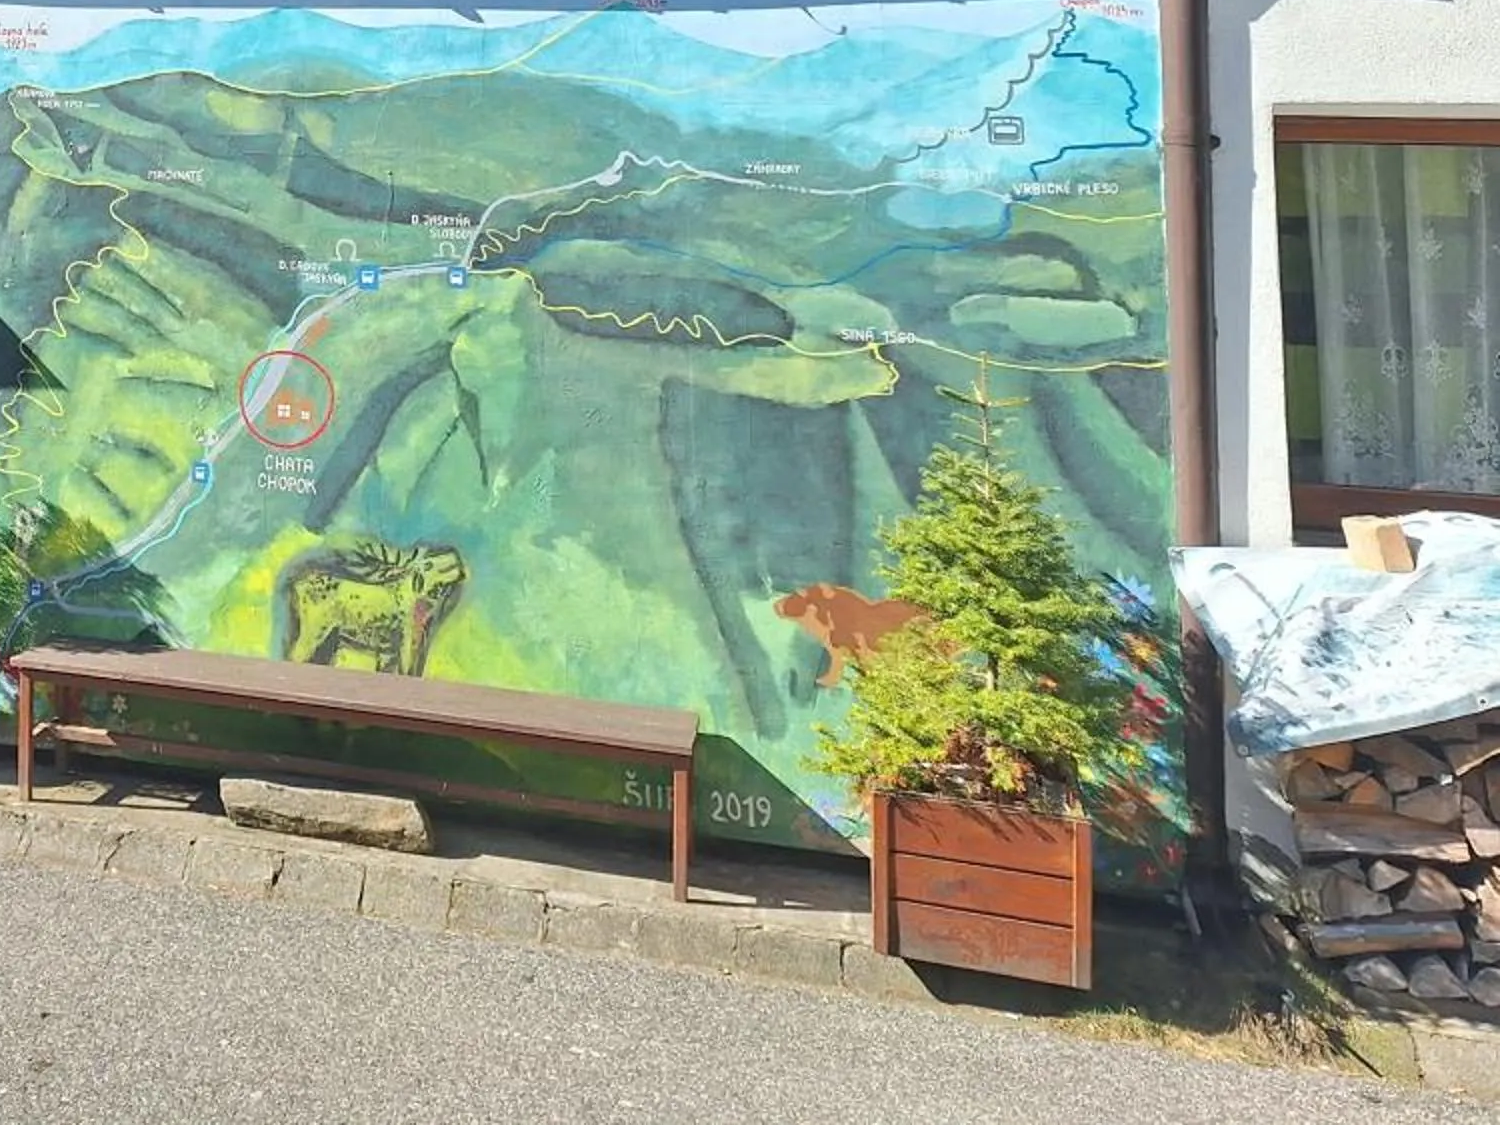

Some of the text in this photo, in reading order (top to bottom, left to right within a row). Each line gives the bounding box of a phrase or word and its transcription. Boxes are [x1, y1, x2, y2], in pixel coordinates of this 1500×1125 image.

[265, 454, 314, 474] CHATA
[257, 472, 317, 496] CHOPOK
[711, 790, 772, 827] 2019
